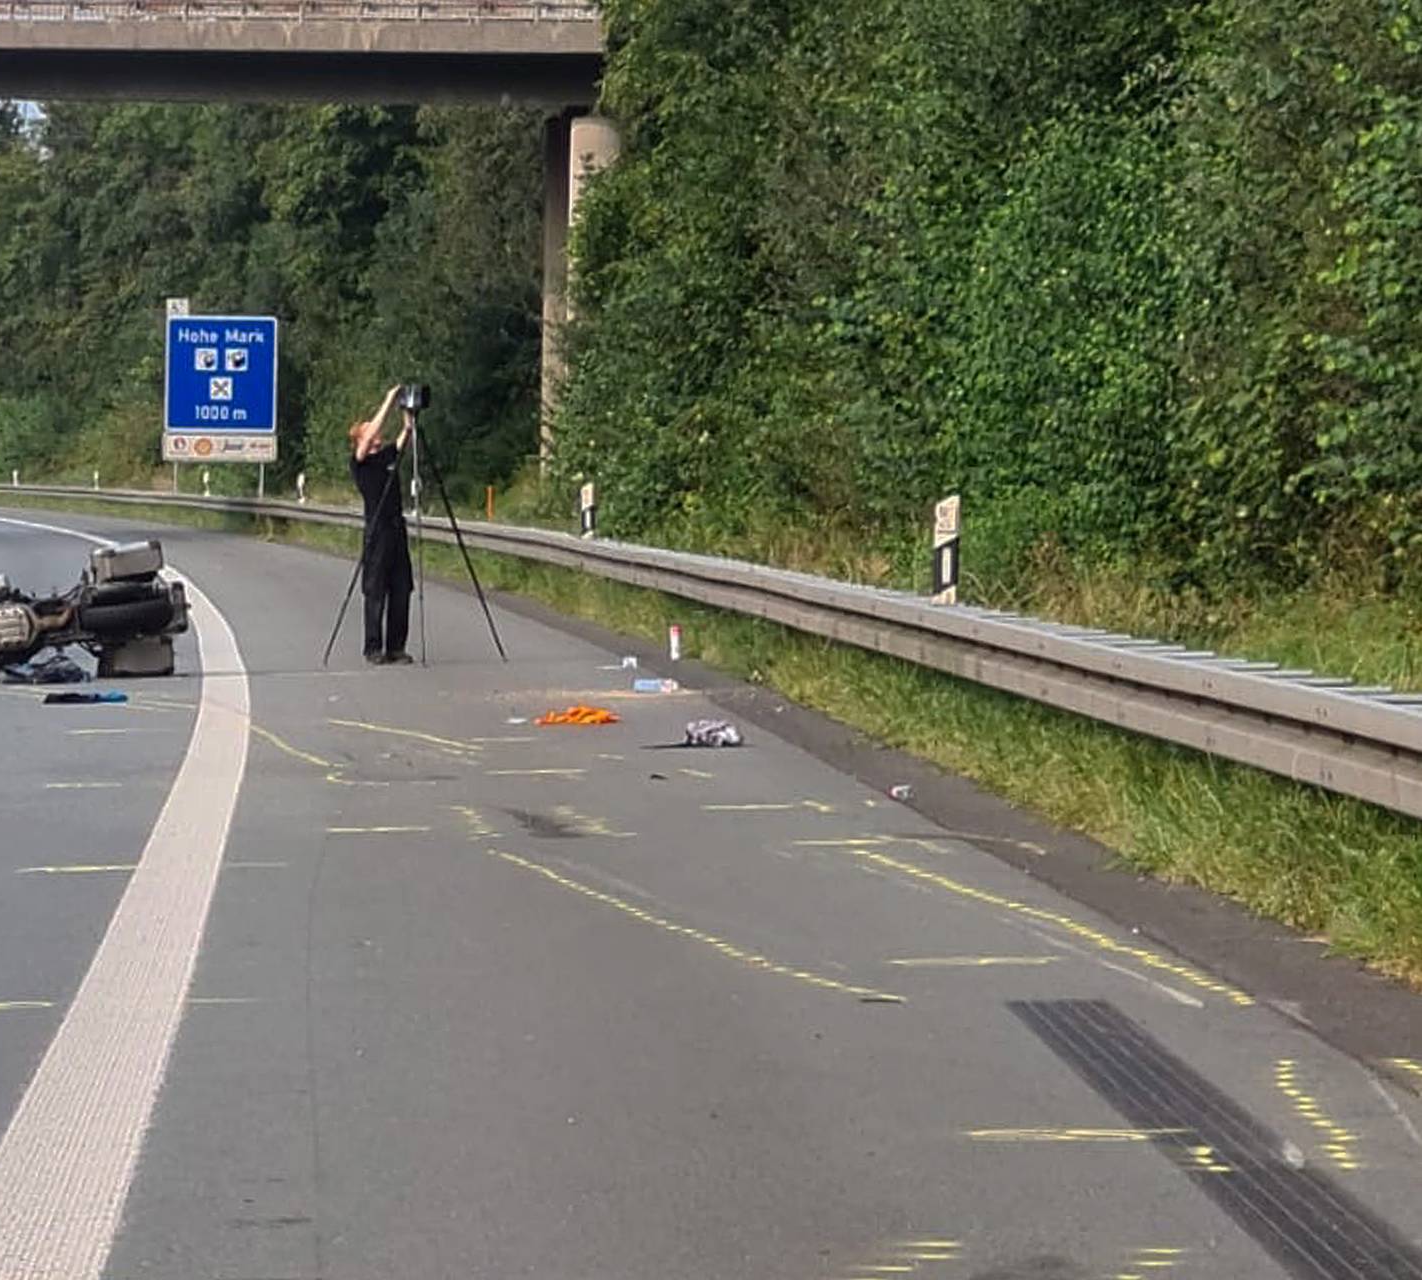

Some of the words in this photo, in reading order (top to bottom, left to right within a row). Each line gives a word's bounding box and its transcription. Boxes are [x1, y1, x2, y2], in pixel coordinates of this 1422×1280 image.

[178, 328, 218, 343] Hohe
[225, 328, 264, 343] Mark
[195, 406, 229, 420] 1000
[233, 410, 248, 420] m
